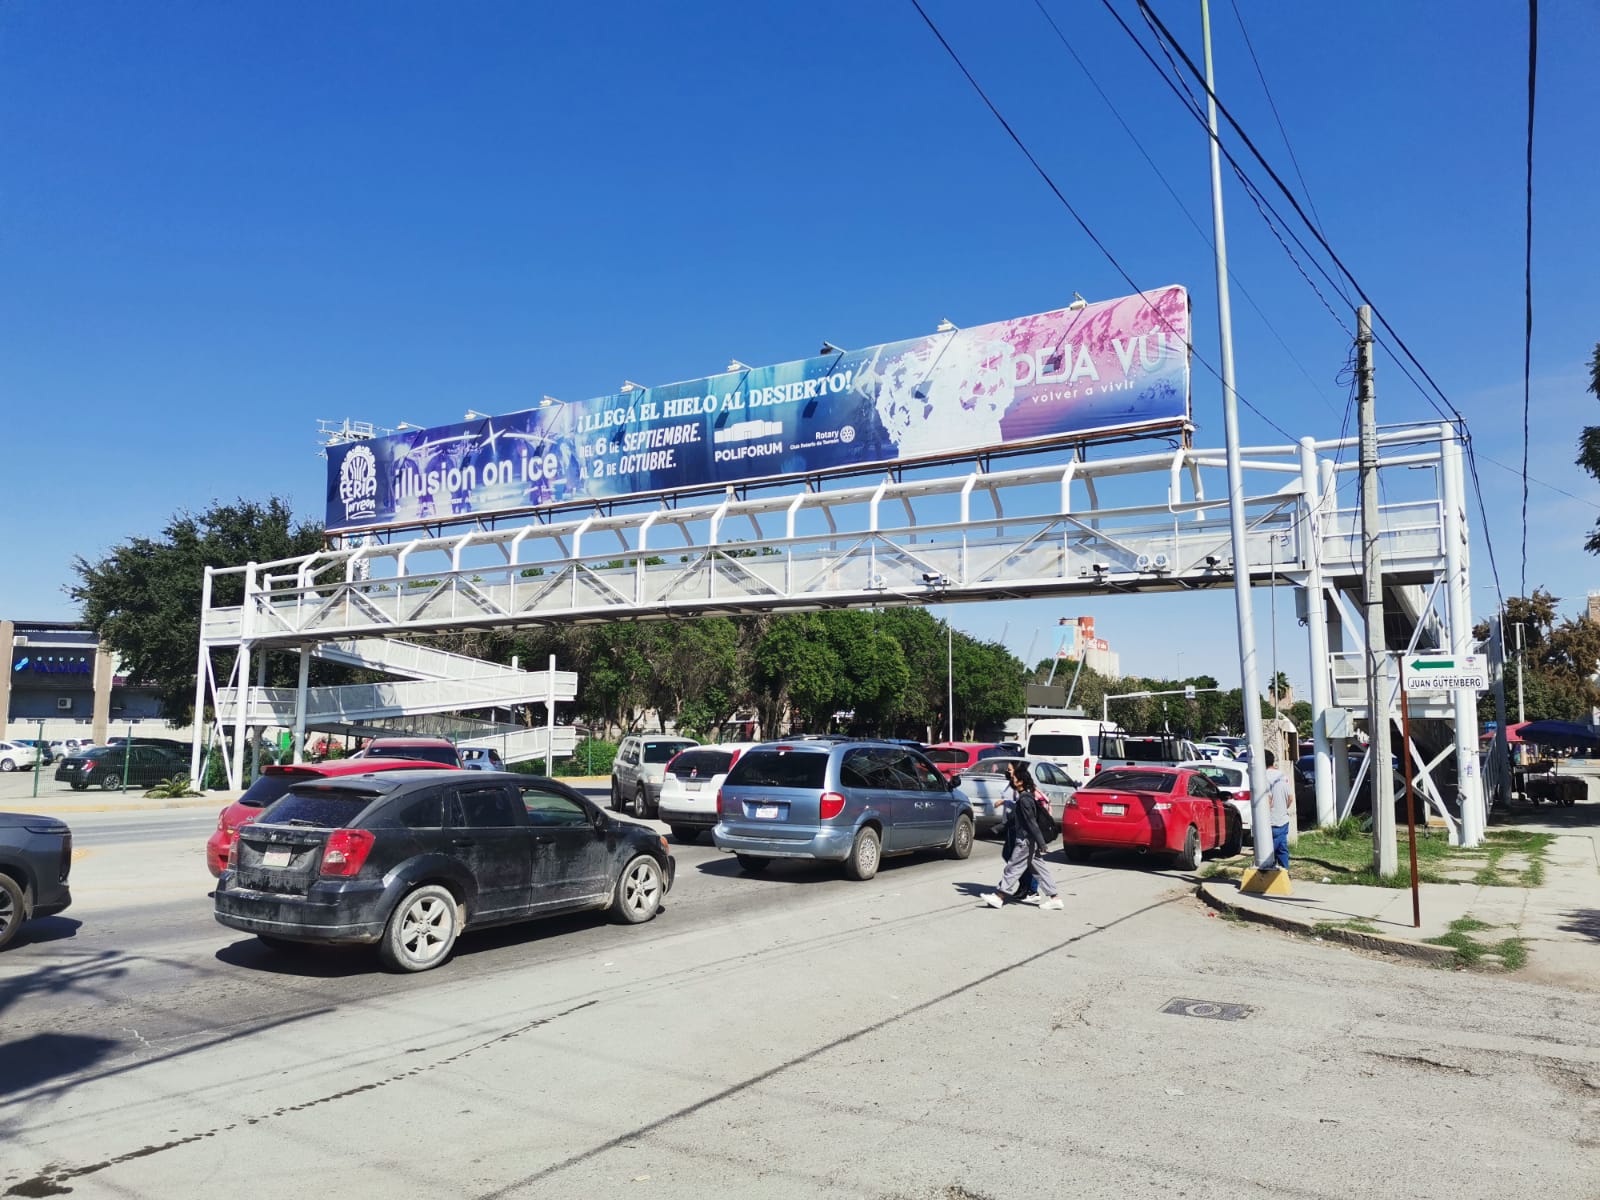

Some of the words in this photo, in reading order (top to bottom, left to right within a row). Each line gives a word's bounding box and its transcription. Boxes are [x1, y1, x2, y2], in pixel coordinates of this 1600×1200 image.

[577, 408, 636, 433] ¡LLEGA
[640, 402, 660, 421] EL
[662, 394, 718, 418] HIELO
[720, 392, 746, 411] AL
[748, 370, 852, 408] DESIERTO!
[1032, 389, 1079, 404] volver
[1085, 386, 1094, 396] a
[1100, 380, 1135, 393] vivir
[595, 437, 607, 455] 6
[609, 441, 620, 454] DE
[623, 422, 701, 452] SEPTIEMBRE.
[815, 430, 839, 440] Rotary
[714, 441, 783, 462] POLIFORUM
[394, 461, 476, 500] illusion
[483, 458, 513, 487] on
[521, 449, 558, 482] ice
[580, 466, 590, 480] AL
[593, 459, 604, 478] 2
[606, 463, 617, 476] DE
[619, 449, 677, 475] OCTUBRE.
[340, 478, 377, 499] FERIA
[1410, 679, 1431, 688] JUAN
[1433, 678, 1481, 688] GUTEMBERG
